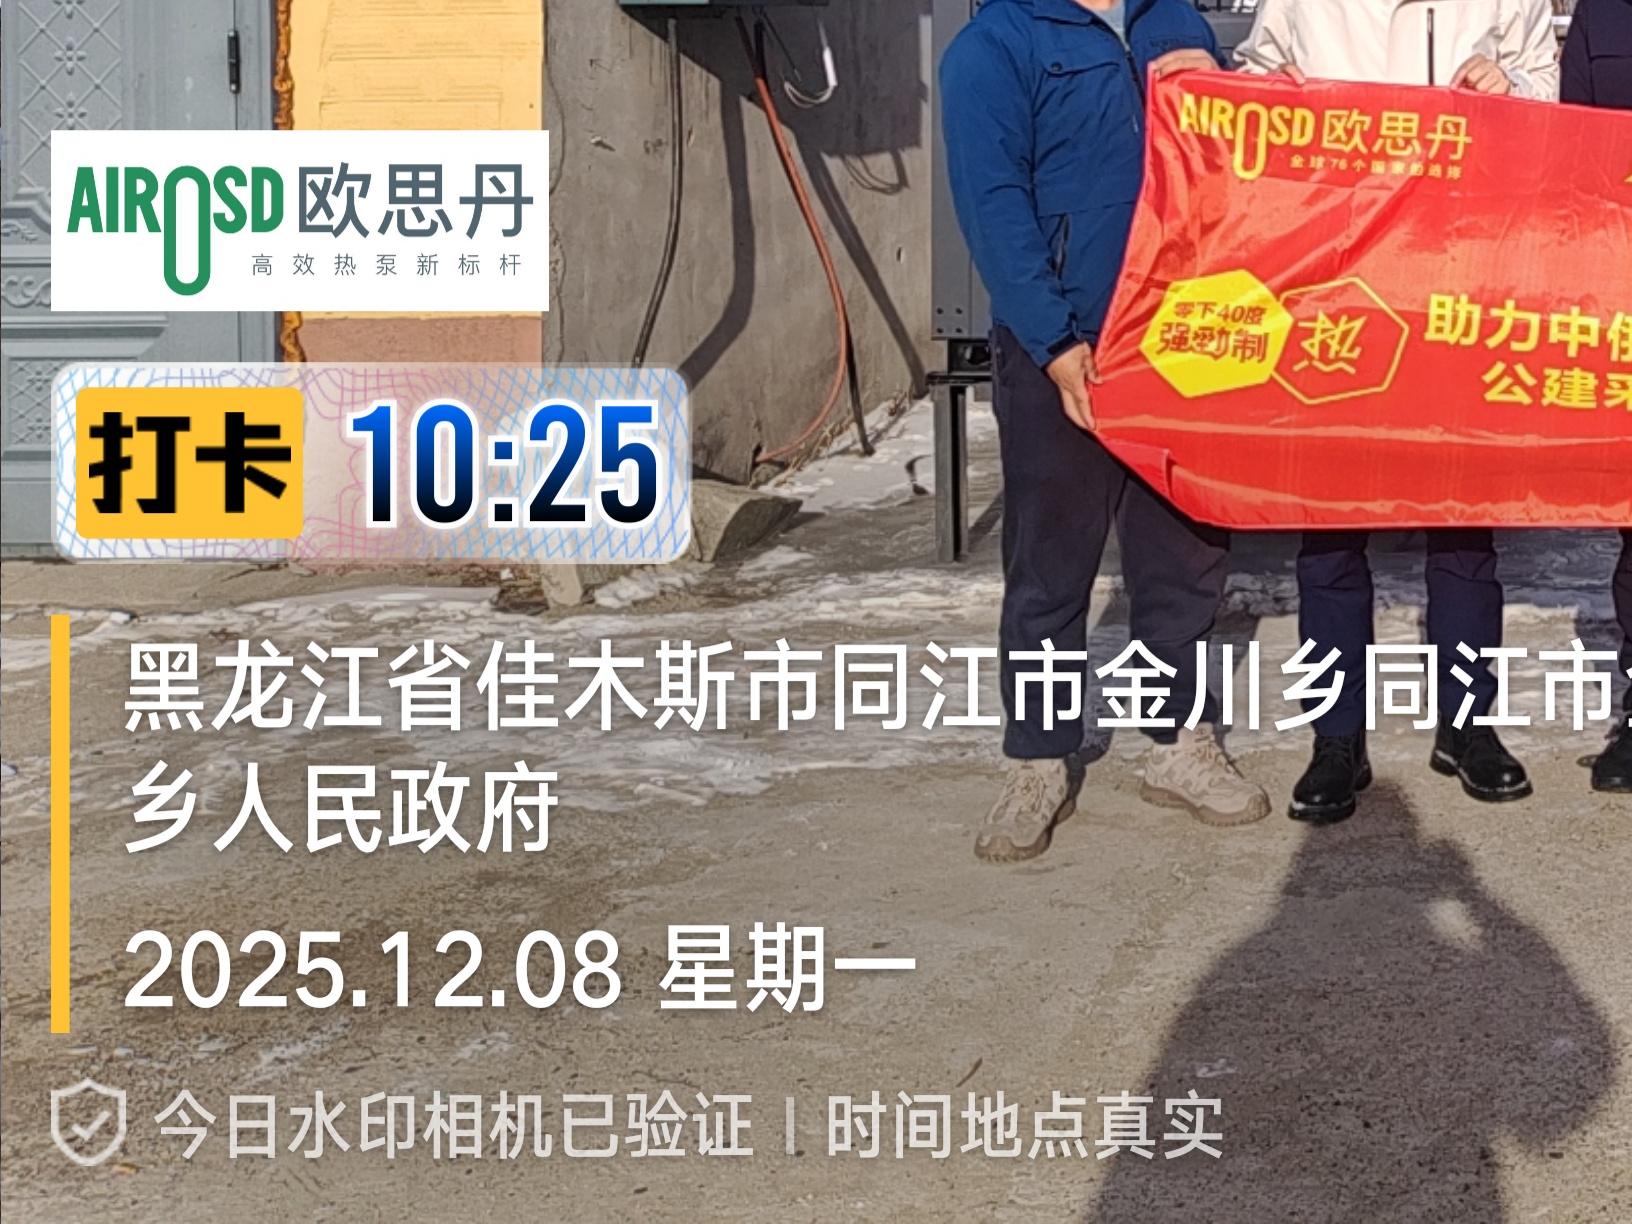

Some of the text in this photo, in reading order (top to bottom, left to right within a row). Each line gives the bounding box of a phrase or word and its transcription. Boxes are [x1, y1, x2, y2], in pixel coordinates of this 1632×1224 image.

[1322, 109, 1473, 161] 欧思丹
[1174, 301, 1268, 326] 零下40度
